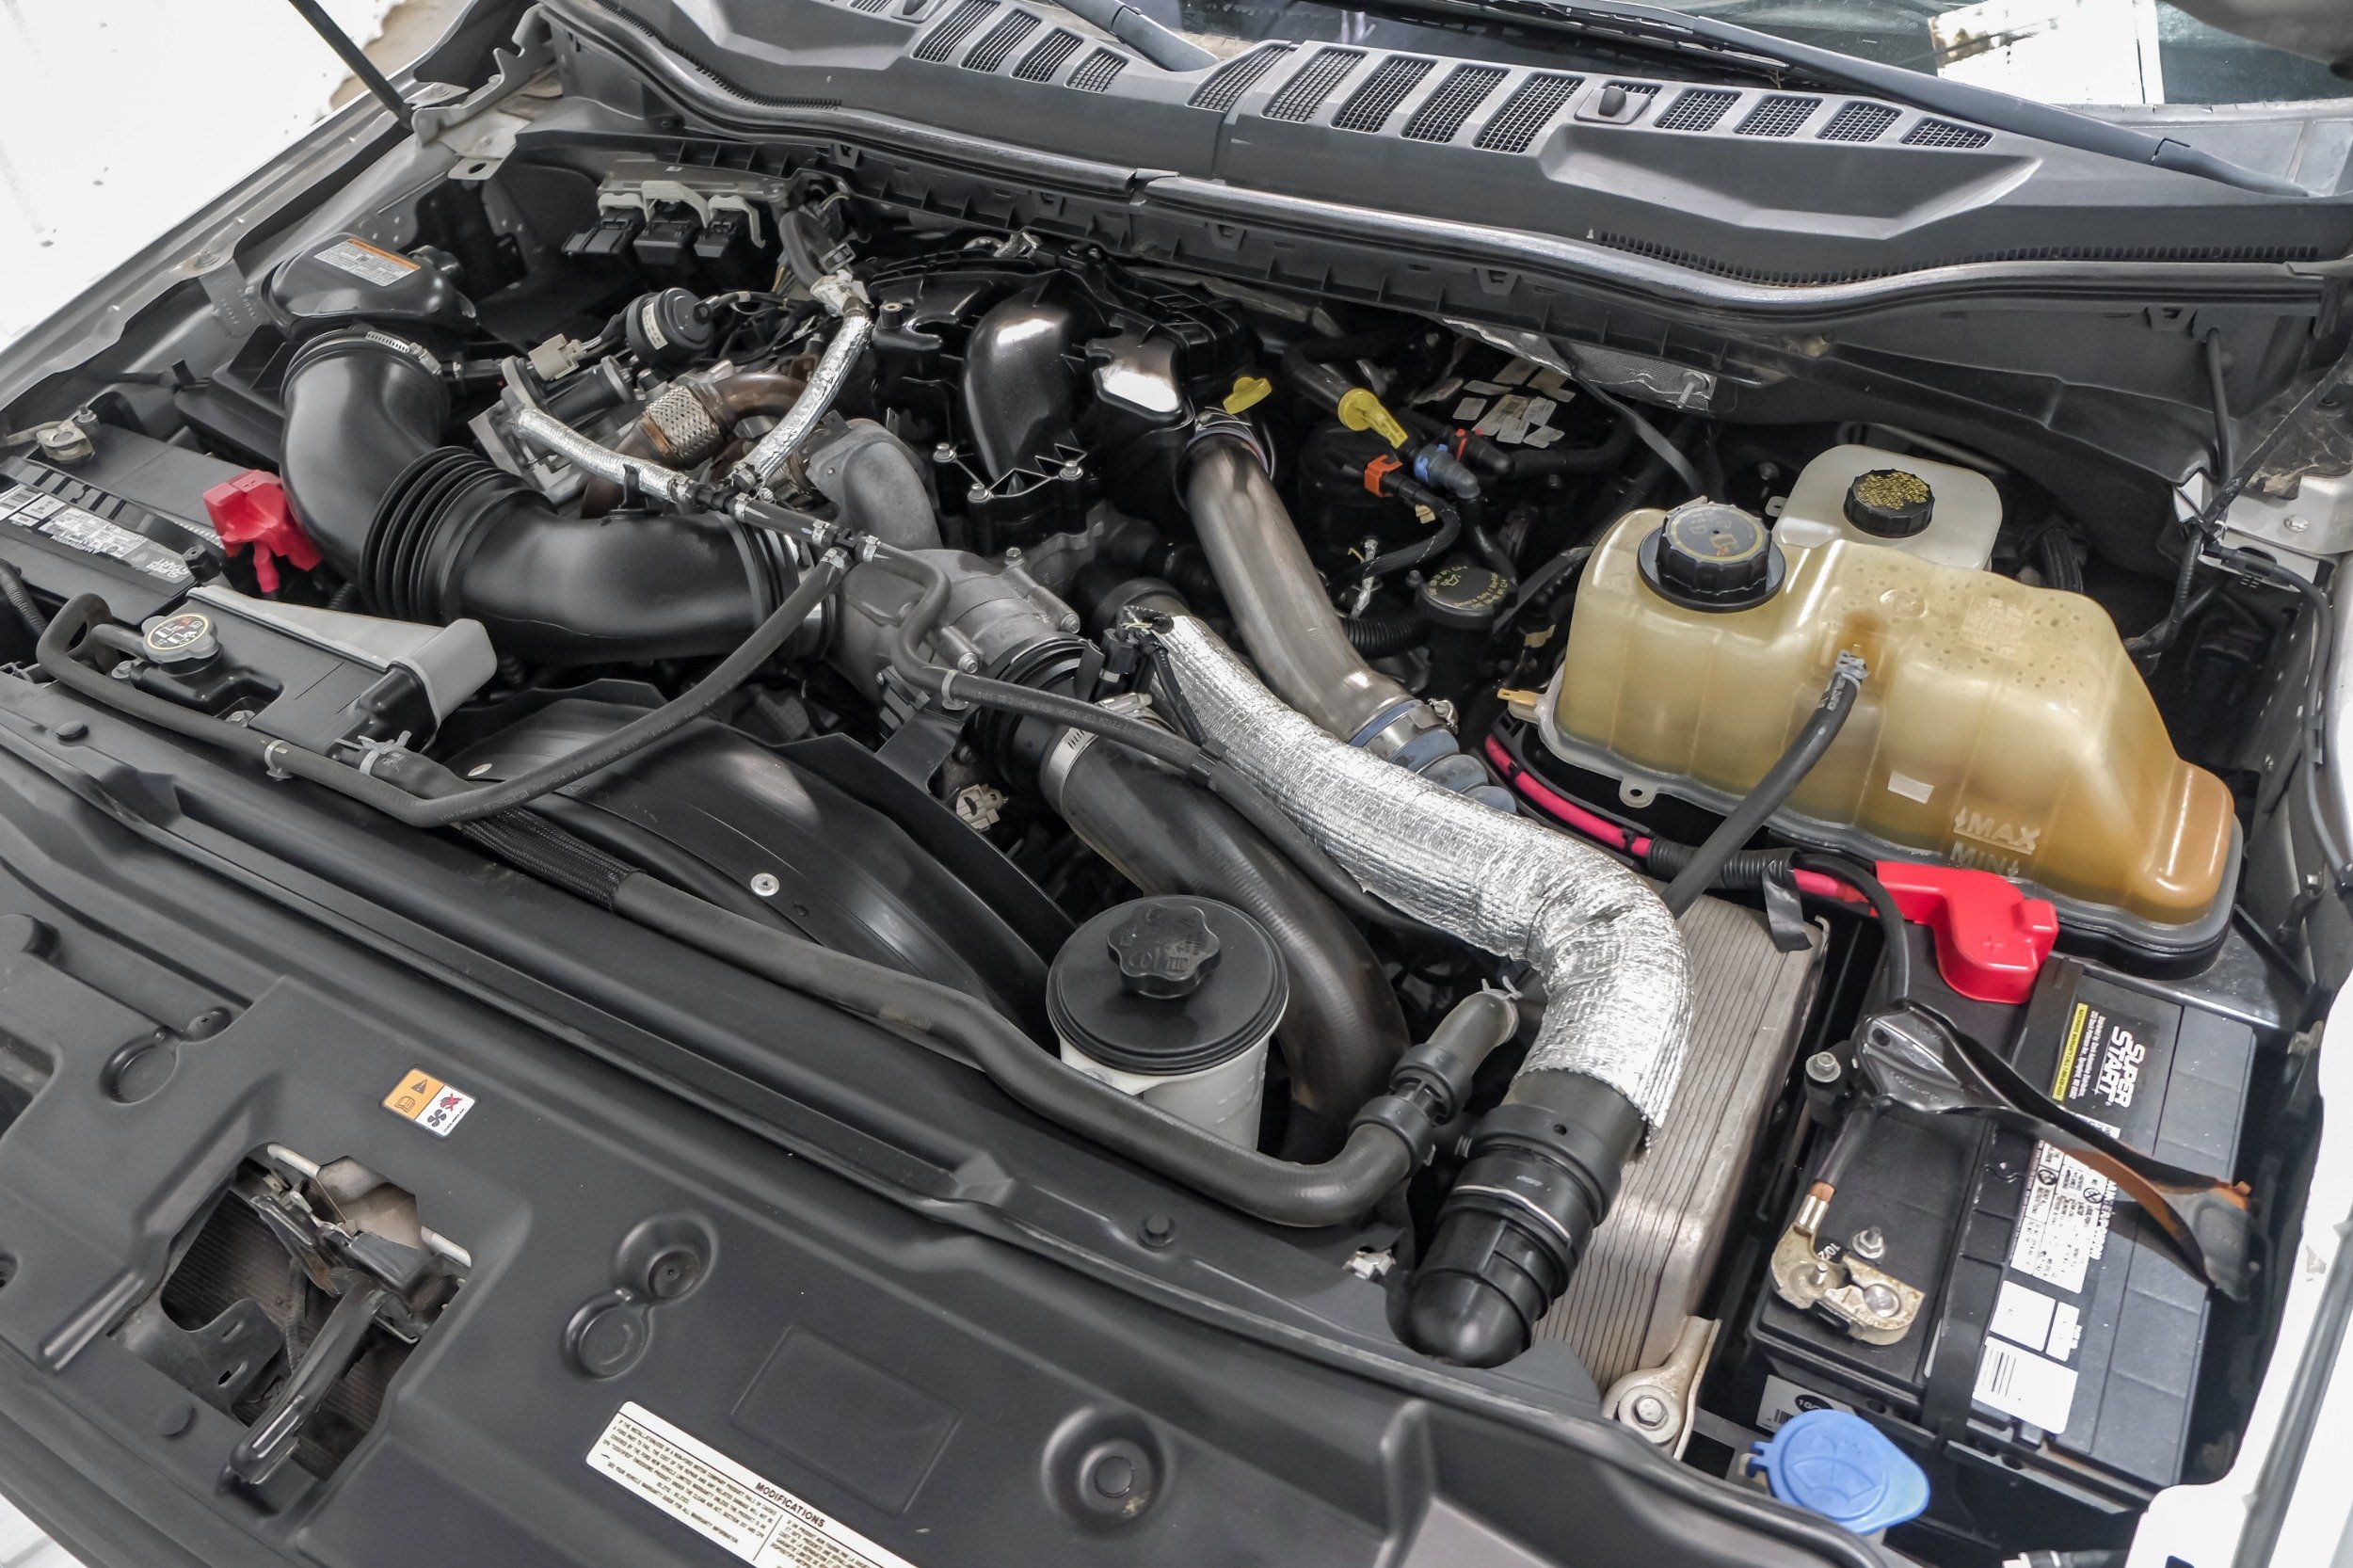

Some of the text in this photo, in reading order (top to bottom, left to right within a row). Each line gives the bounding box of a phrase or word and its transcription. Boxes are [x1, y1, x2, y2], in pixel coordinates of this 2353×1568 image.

[1967, 810, 2041, 851] MAX
[1950, 841, 2008, 875] MIN
[2099, 1026, 2133, 1103] START
[2114, 1043, 2146, 1108] SUPER
[756, 1482, 825, 1528] MODIFICATIONS
